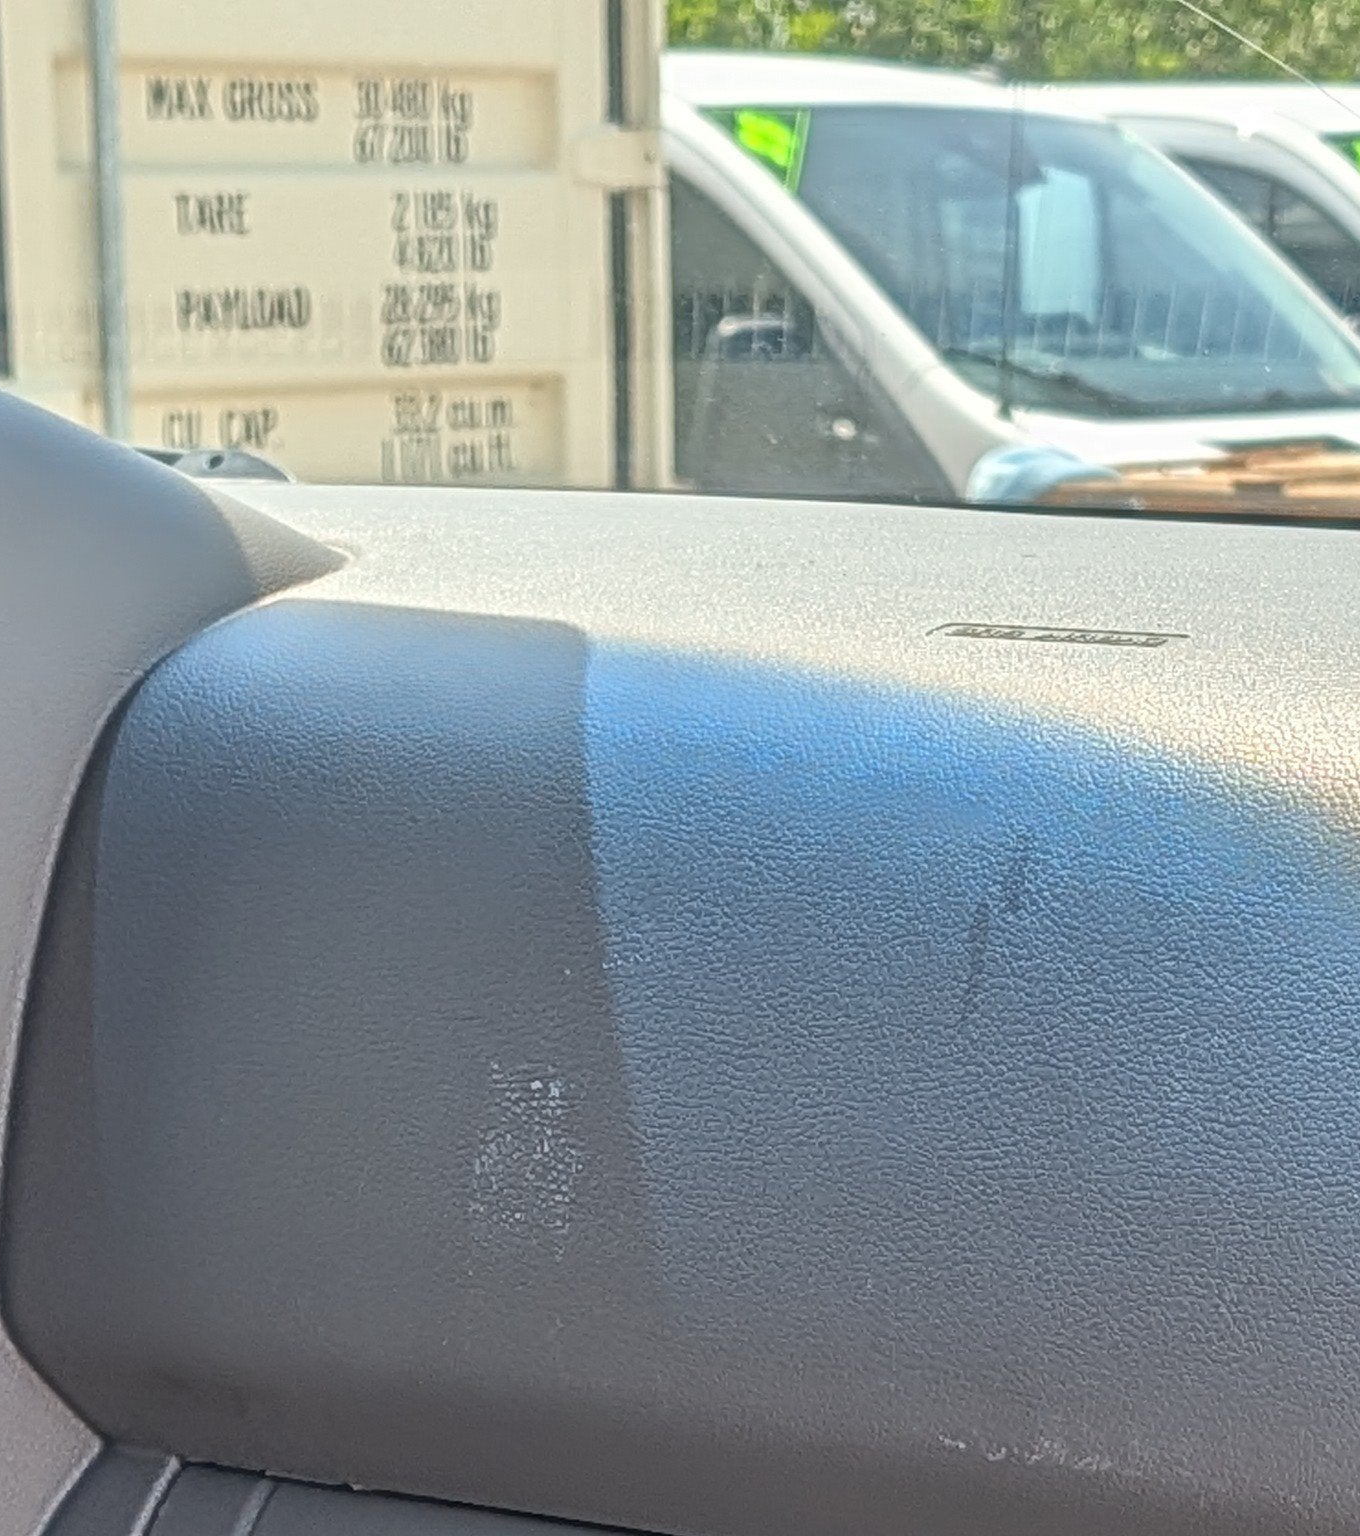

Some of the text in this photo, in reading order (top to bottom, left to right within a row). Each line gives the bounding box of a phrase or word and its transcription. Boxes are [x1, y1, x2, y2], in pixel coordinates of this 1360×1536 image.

[145, 76, 320, 122] MAX GROSS
[174, 191, 251, 235] TARE
[177, 284, 312, 332] PAYLOAD
